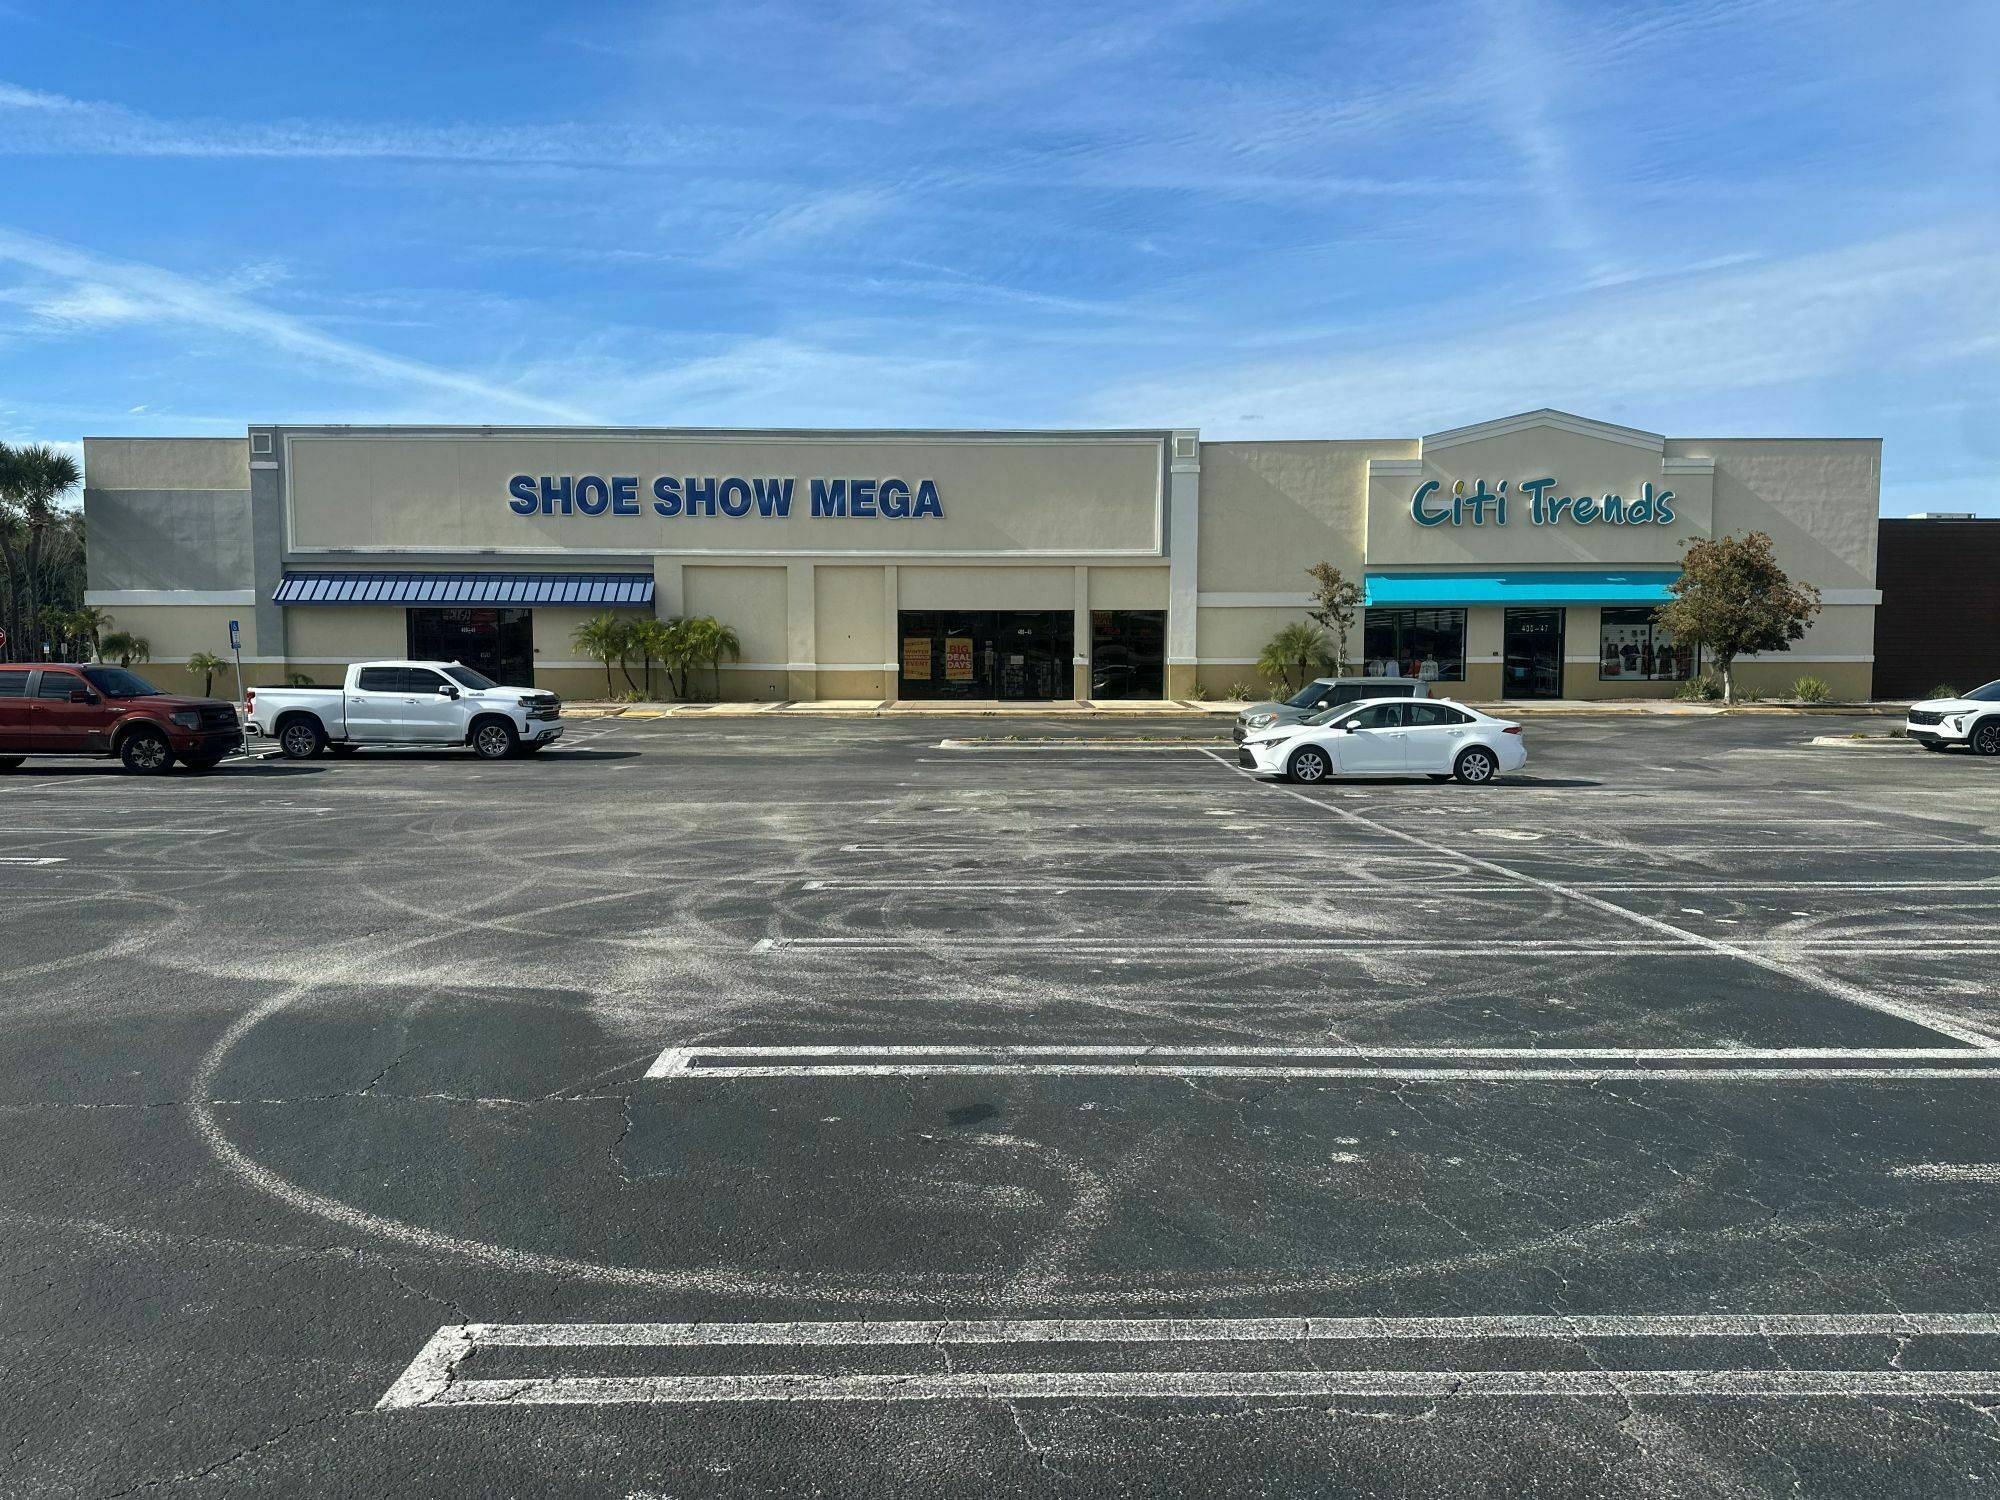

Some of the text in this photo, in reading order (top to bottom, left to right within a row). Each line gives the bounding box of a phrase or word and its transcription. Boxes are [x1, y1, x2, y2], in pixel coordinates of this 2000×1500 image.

[508, 474, 945, 519] SHOE SHOW MEGA
[1411, 477, 1676, 526] Citi Trends
[950, 645, 969, 654] BIG
[946, 653, 971, 661] DEAL
[947, 661, 972, 669] DAYS
